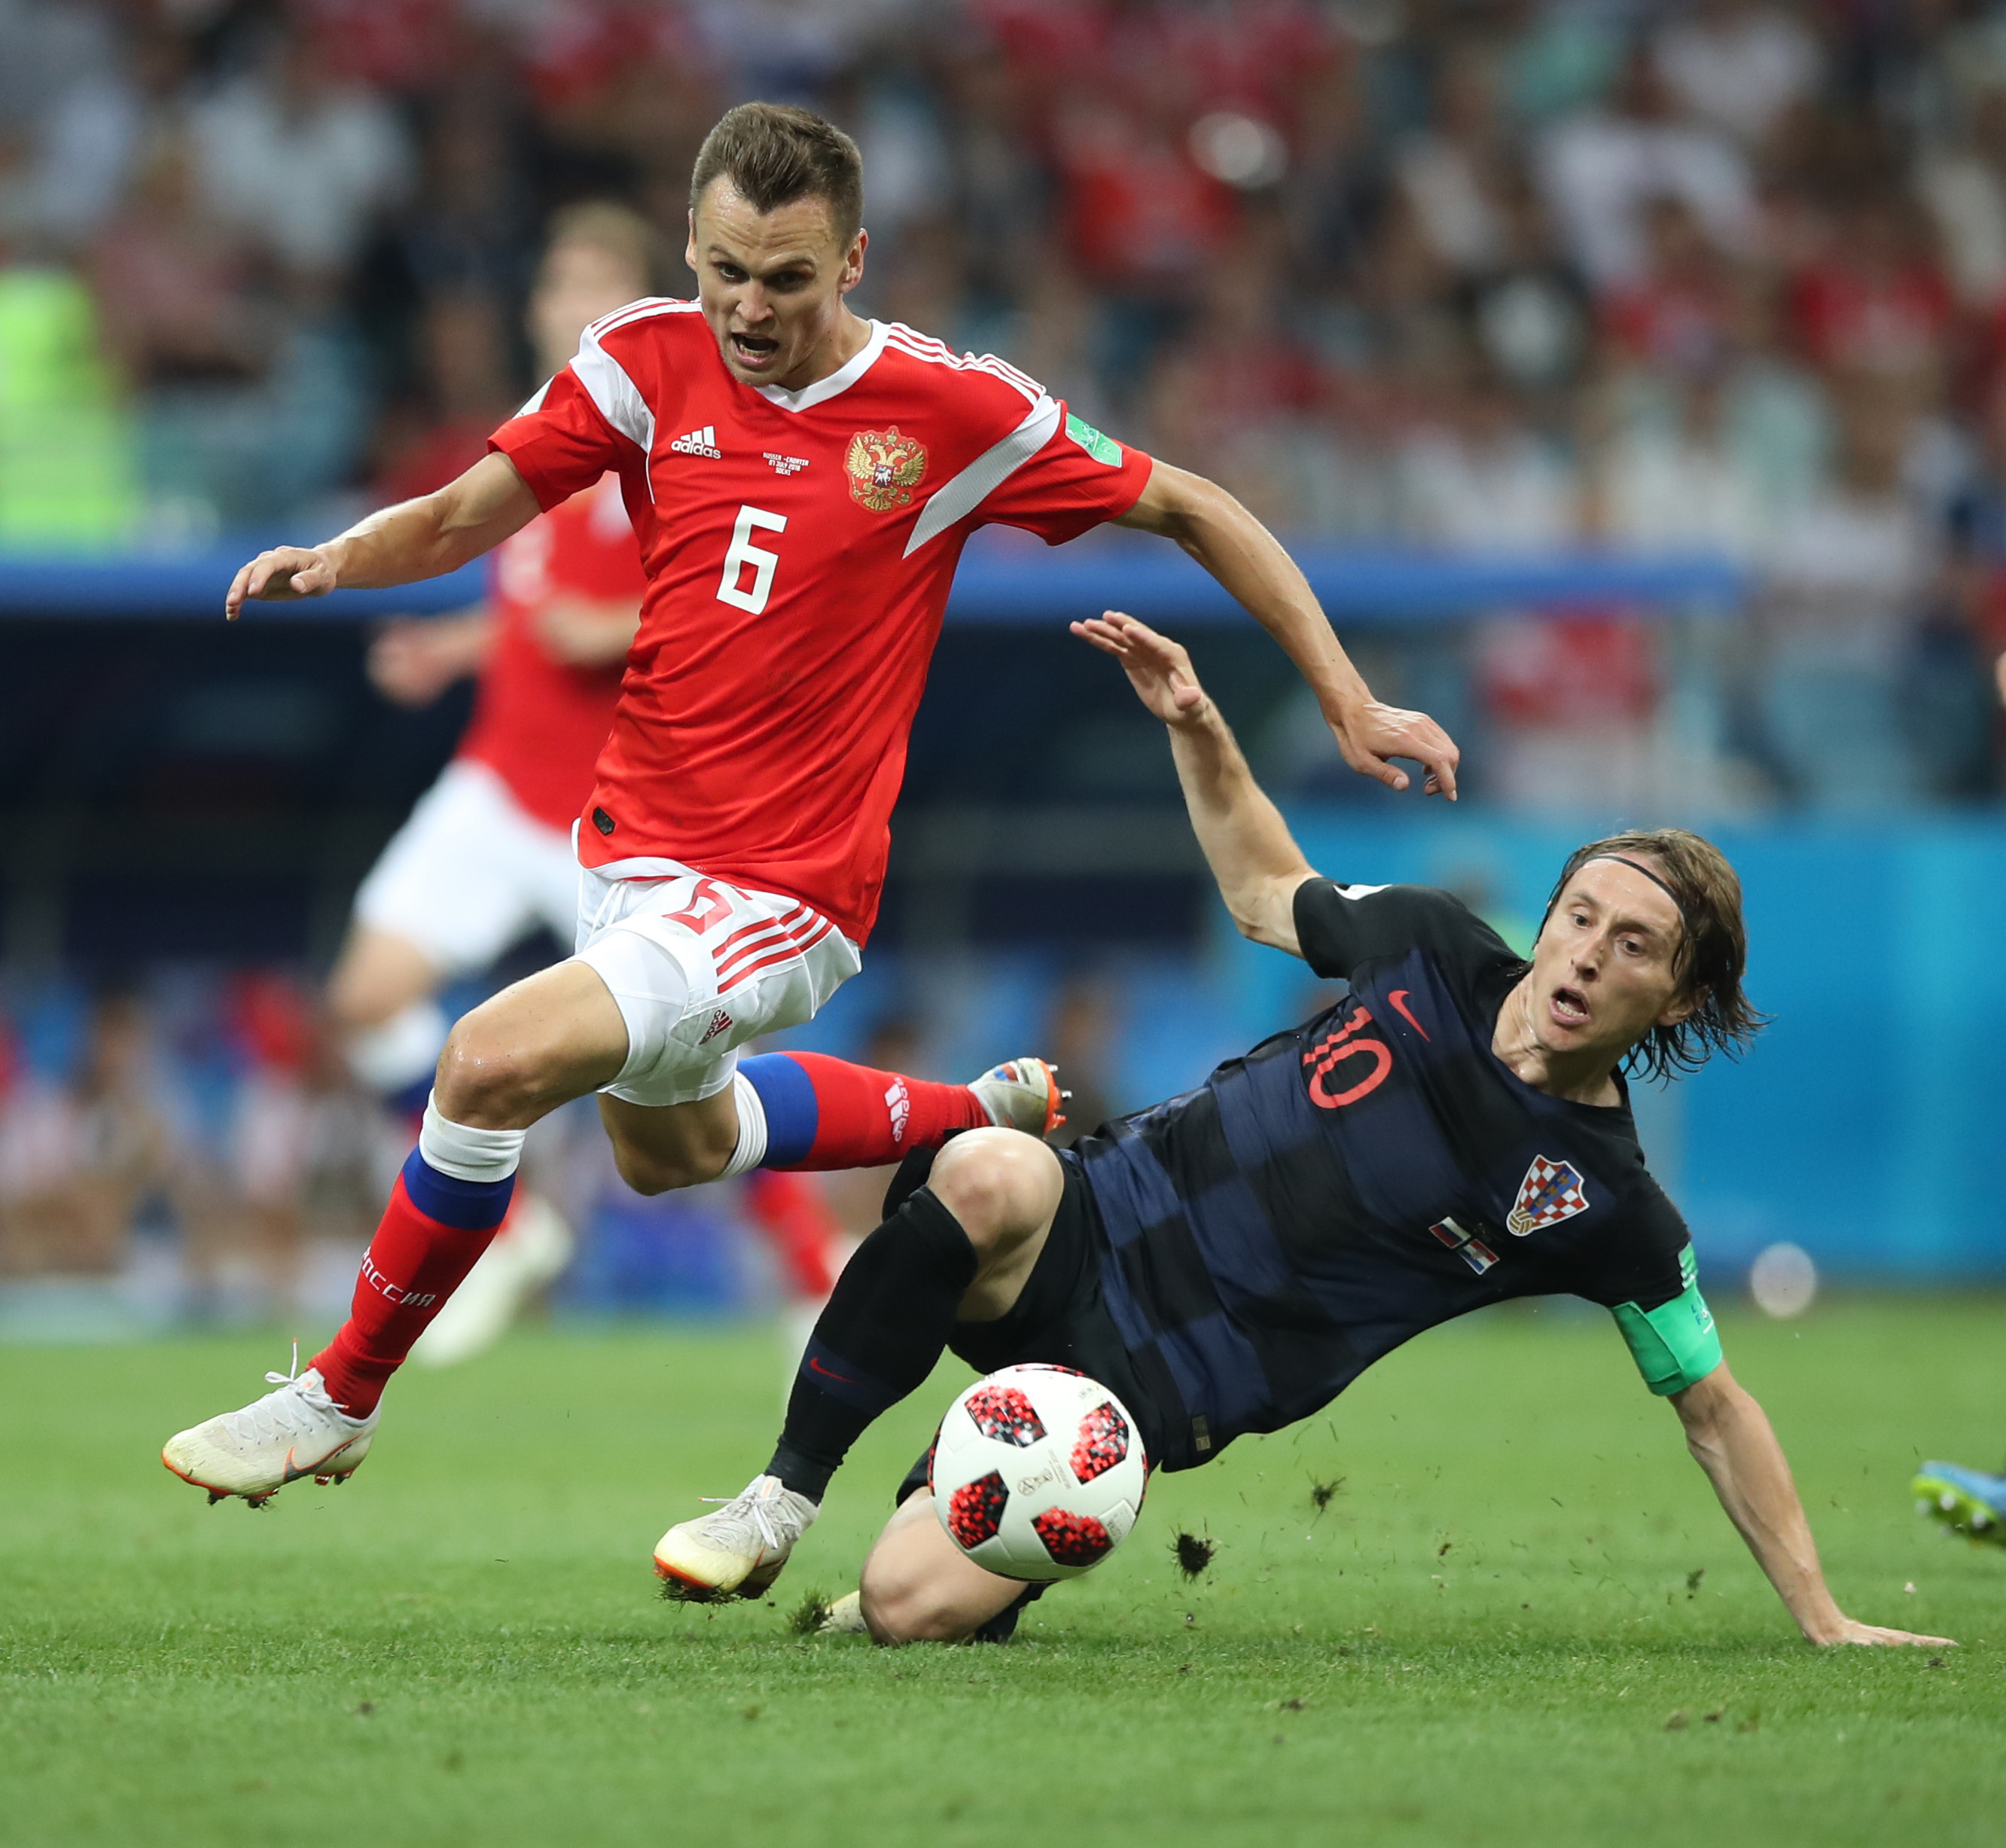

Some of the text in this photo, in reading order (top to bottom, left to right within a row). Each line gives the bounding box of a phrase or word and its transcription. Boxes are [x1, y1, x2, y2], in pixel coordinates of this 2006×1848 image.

[671, 440, 721, 459] adidas
[716, 505, 788, 615] 6
[661, 878, 753, 935] 6
[1303, 1006, 1392, 1108] 10
